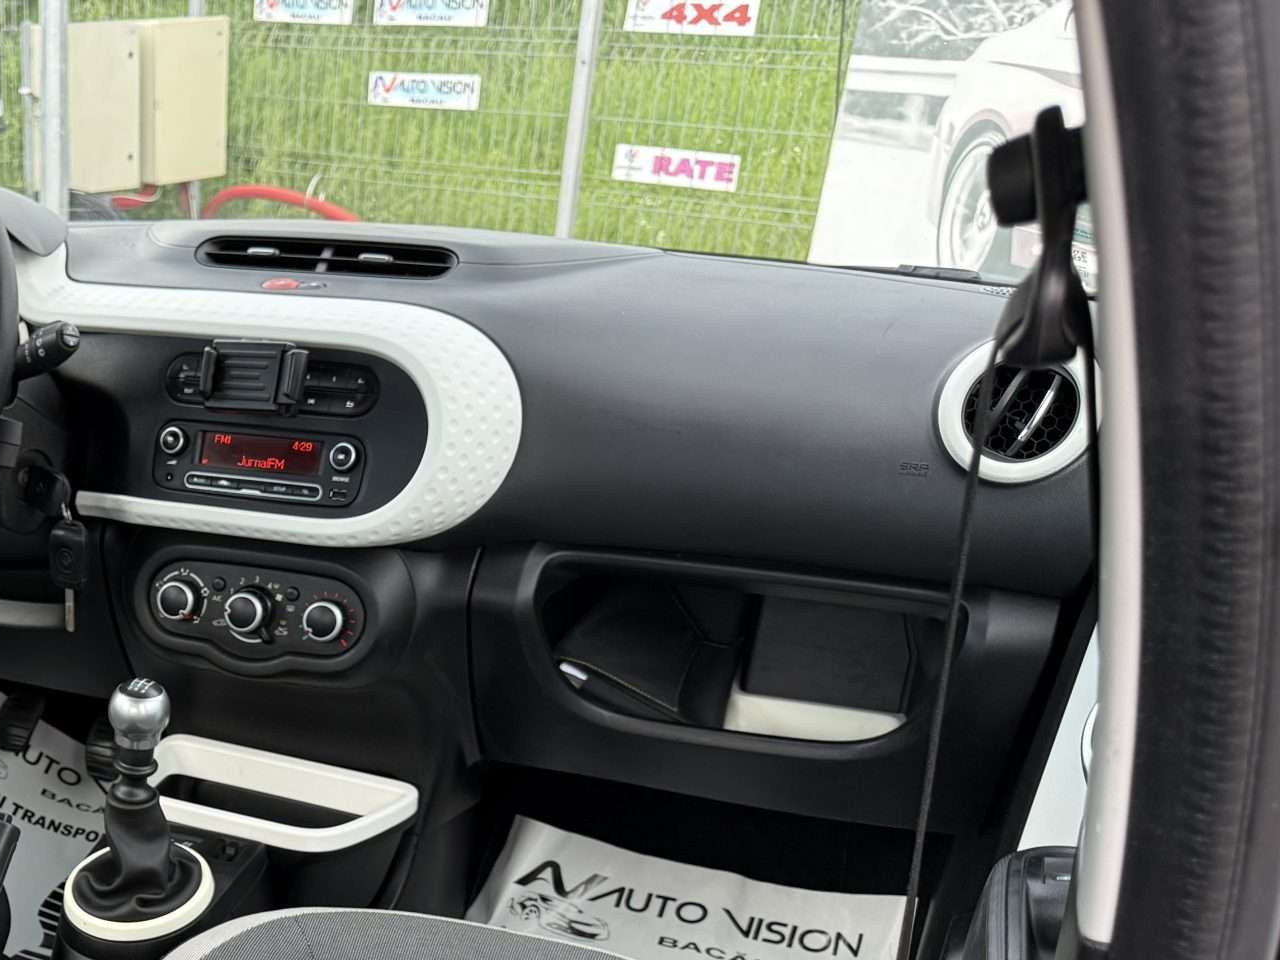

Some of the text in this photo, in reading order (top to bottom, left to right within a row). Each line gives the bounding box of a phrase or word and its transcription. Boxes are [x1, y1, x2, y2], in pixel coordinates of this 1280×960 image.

[661, 2, 751, 27] 4X4
[652, 156, 736, 183] RATE
[13, 744, 83, 787] UTO
[587, 886, 864, 958] AUTO VISION
